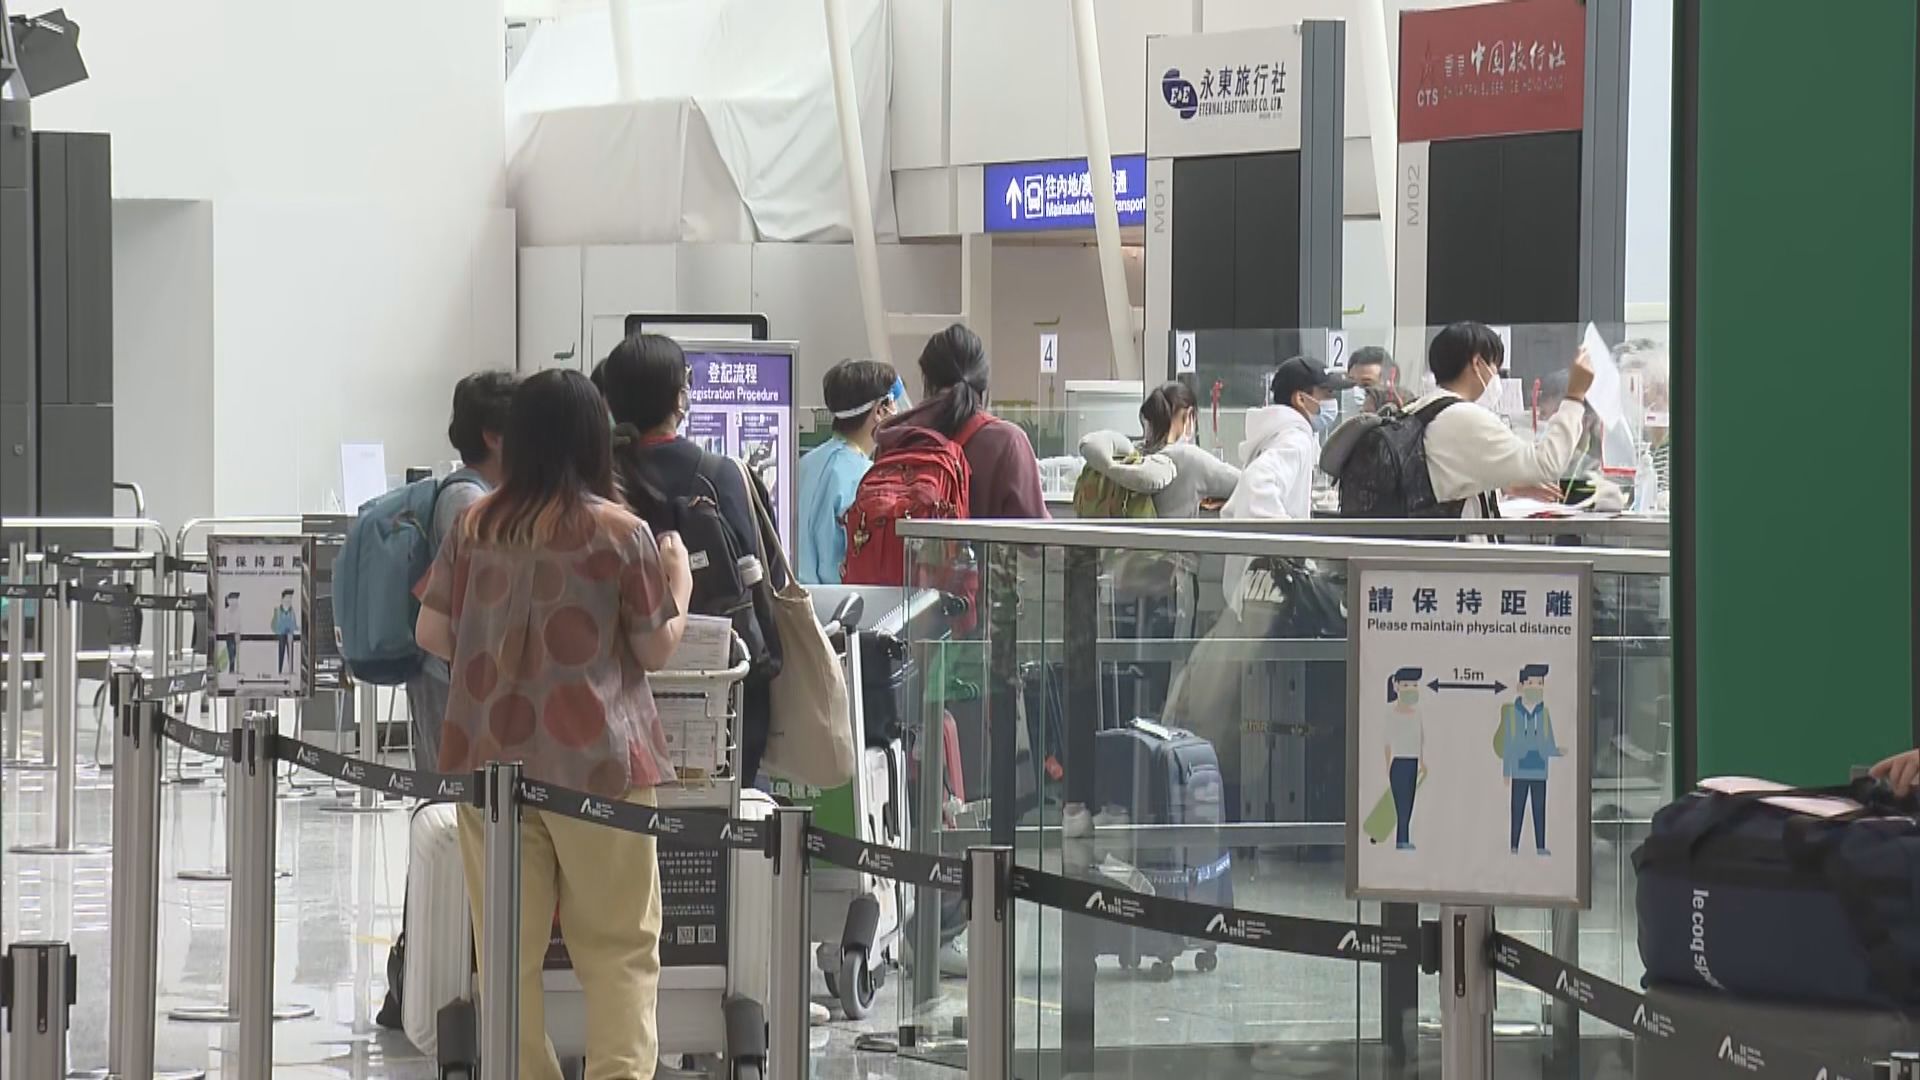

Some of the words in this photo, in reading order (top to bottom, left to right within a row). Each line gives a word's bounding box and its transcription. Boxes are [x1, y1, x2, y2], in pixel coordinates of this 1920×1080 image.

[1200, 61, 1286, 99] 永東旅行社
[1199, 101, 1223, 117] ETERNAL
[1224, 99, 1238, 115] EAST
[1239, 98, 1257, 113] TOURS
[1417, 88, 1438, 106] CTS
[1114, 196, 1146, 215] ransport
[1407, 164, 1420, 226] M02
[1043, 341, 1054, 368] 4
[1181, 338, 1192, 368] 3
[1333, 337, 1344, 367] 2
[708, 362, 757, 384] 登記流程
[737, 386, 779, 401] Procedure
[1368, 586, 1572, 617] 請保持距離
[1367, 618, 1408, 631] Please
[1410, 619, 1464, 633] maintain
[1466, 620, 1517, 635] physical
[1519, 621, 1571, 635] distance
[1453, 667, 1484, 681] 1.5m
[1692, 889, 1709, 909] le
[1690, 912, 1704, 951] coq
